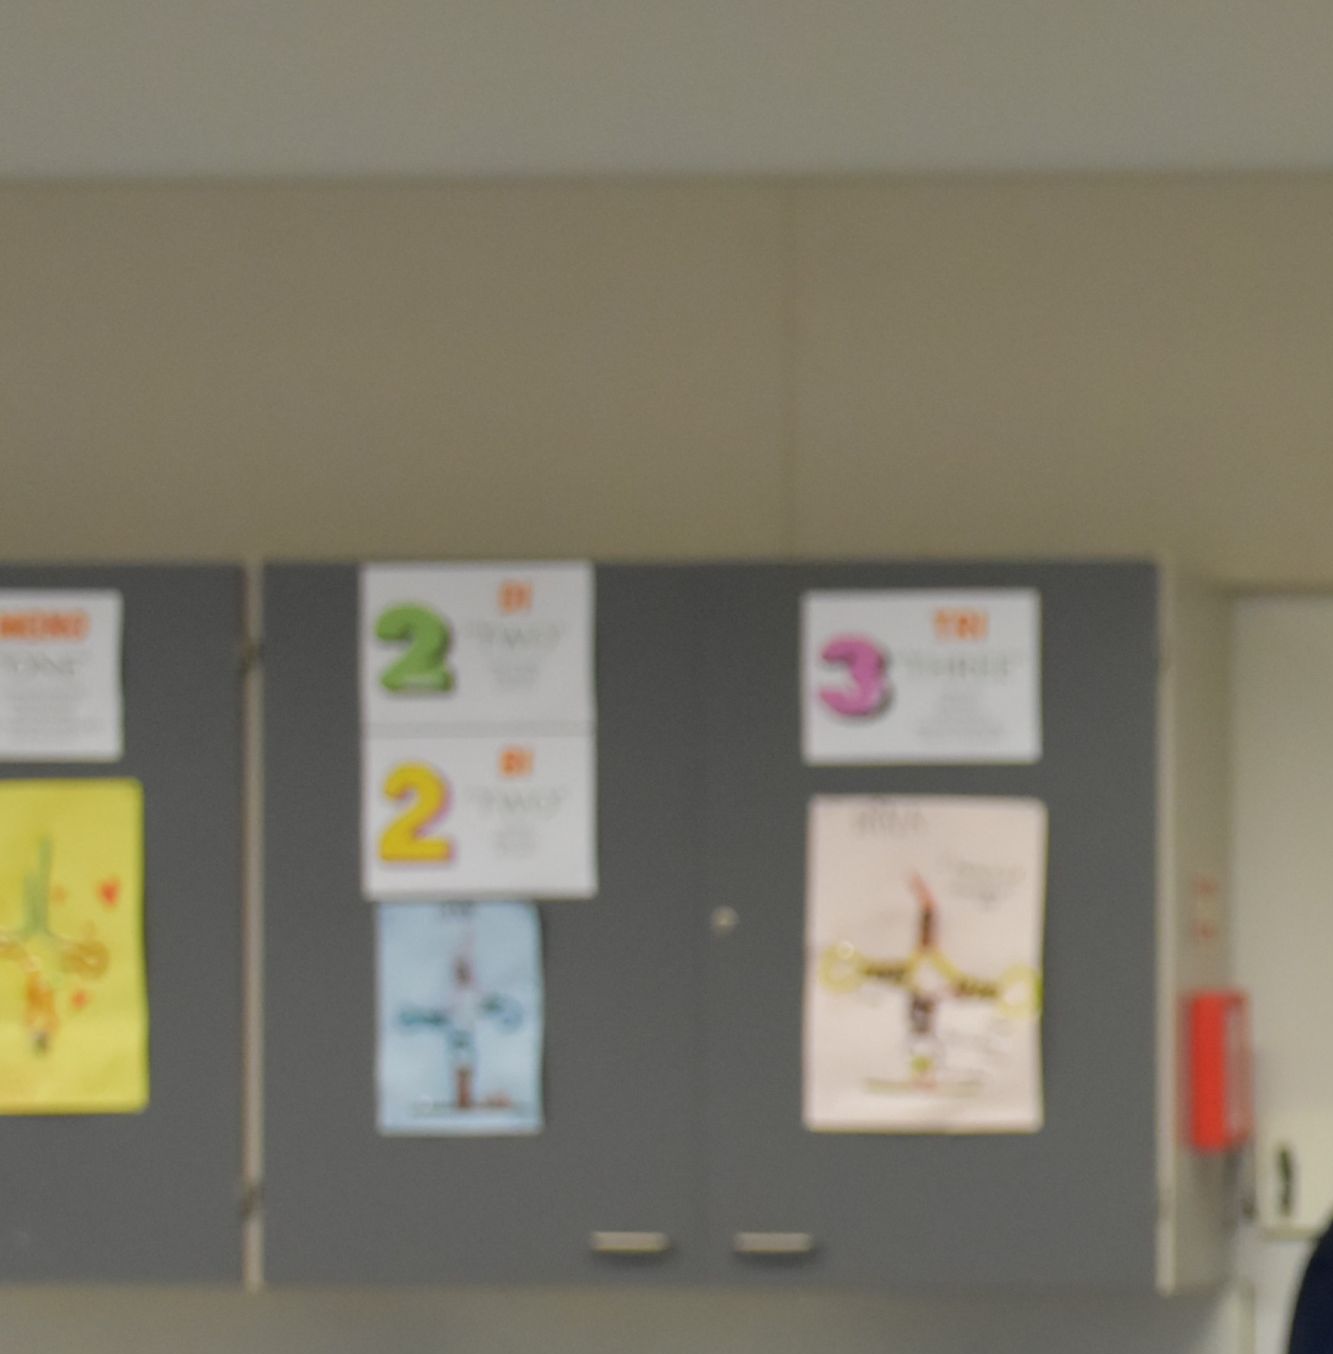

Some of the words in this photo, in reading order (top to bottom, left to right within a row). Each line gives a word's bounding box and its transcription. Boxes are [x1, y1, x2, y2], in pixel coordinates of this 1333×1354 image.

[374, 602, 456, 694] 2
[818, 633, 889, 720] 3
[378, 760, 455, 864] 2
